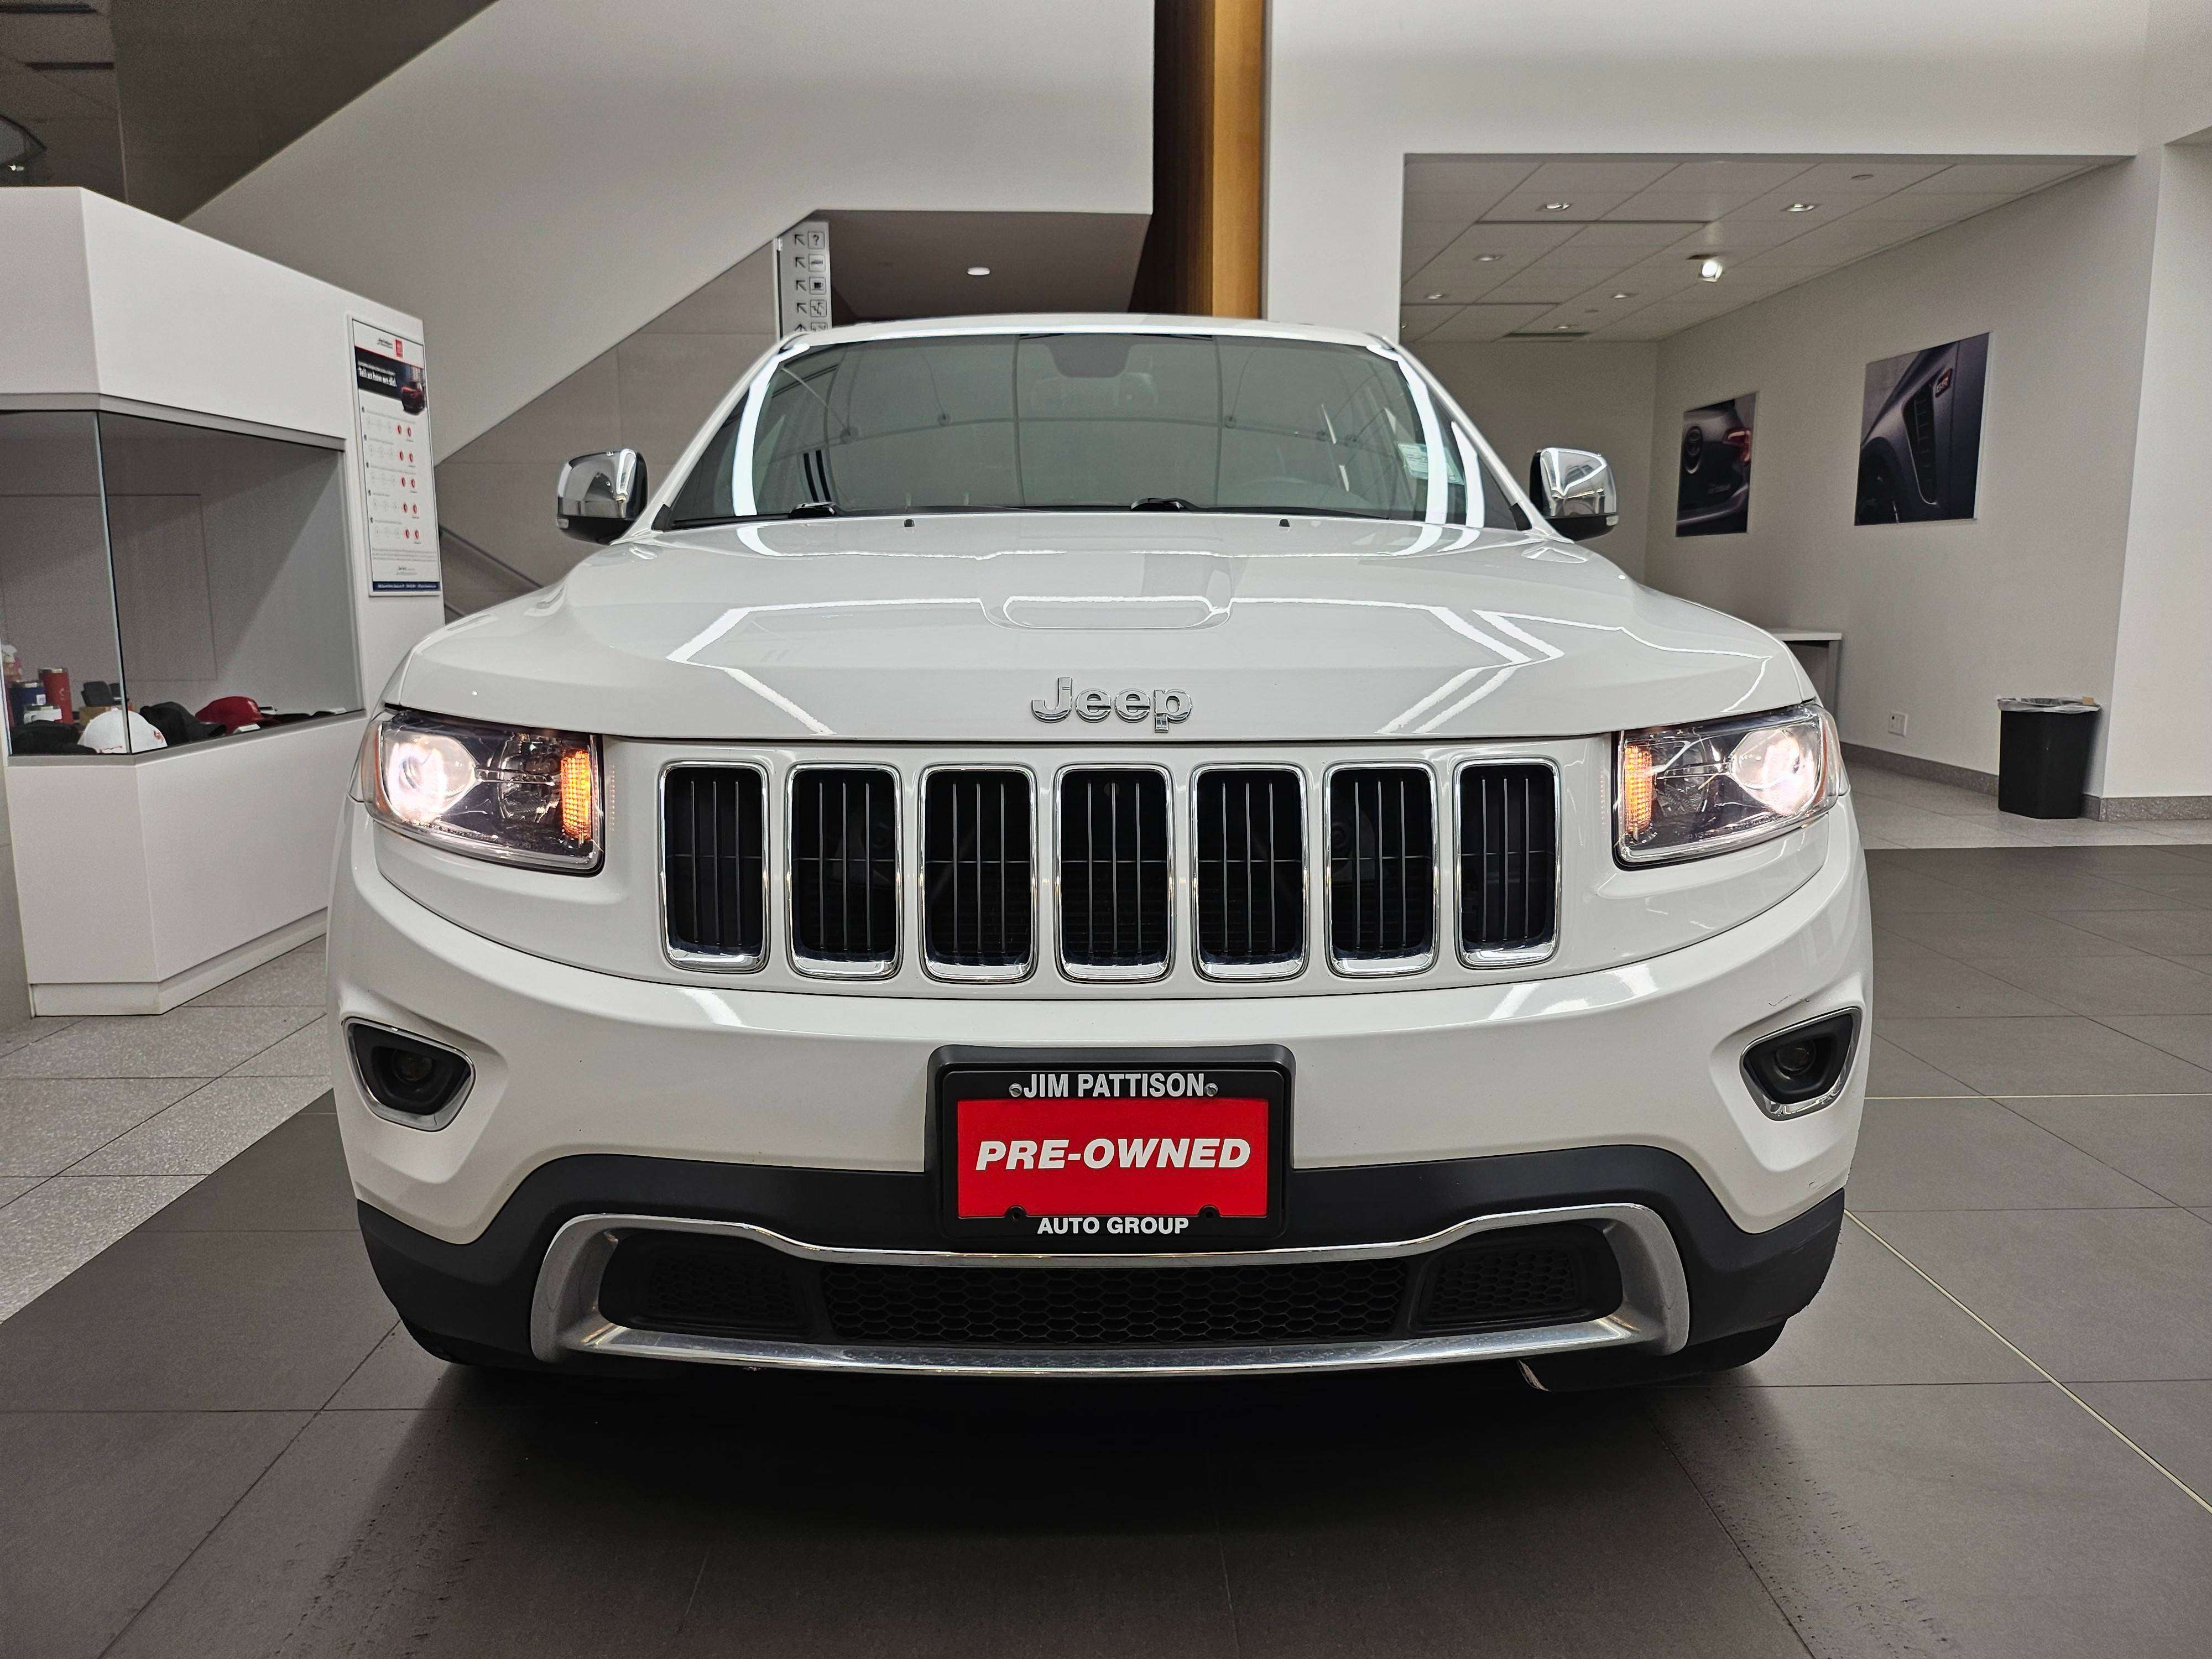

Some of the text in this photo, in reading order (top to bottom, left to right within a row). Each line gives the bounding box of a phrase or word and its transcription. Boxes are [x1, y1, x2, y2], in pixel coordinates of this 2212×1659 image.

[1031, 677, 1192, 733] Jeep
[1024, 1073, 1204, 1098] JIM PATTISON
[975, 1138, 1251, 1171] PRE-OWNED
[1037, 1217, 1189, 1234] AUTO GROUP
